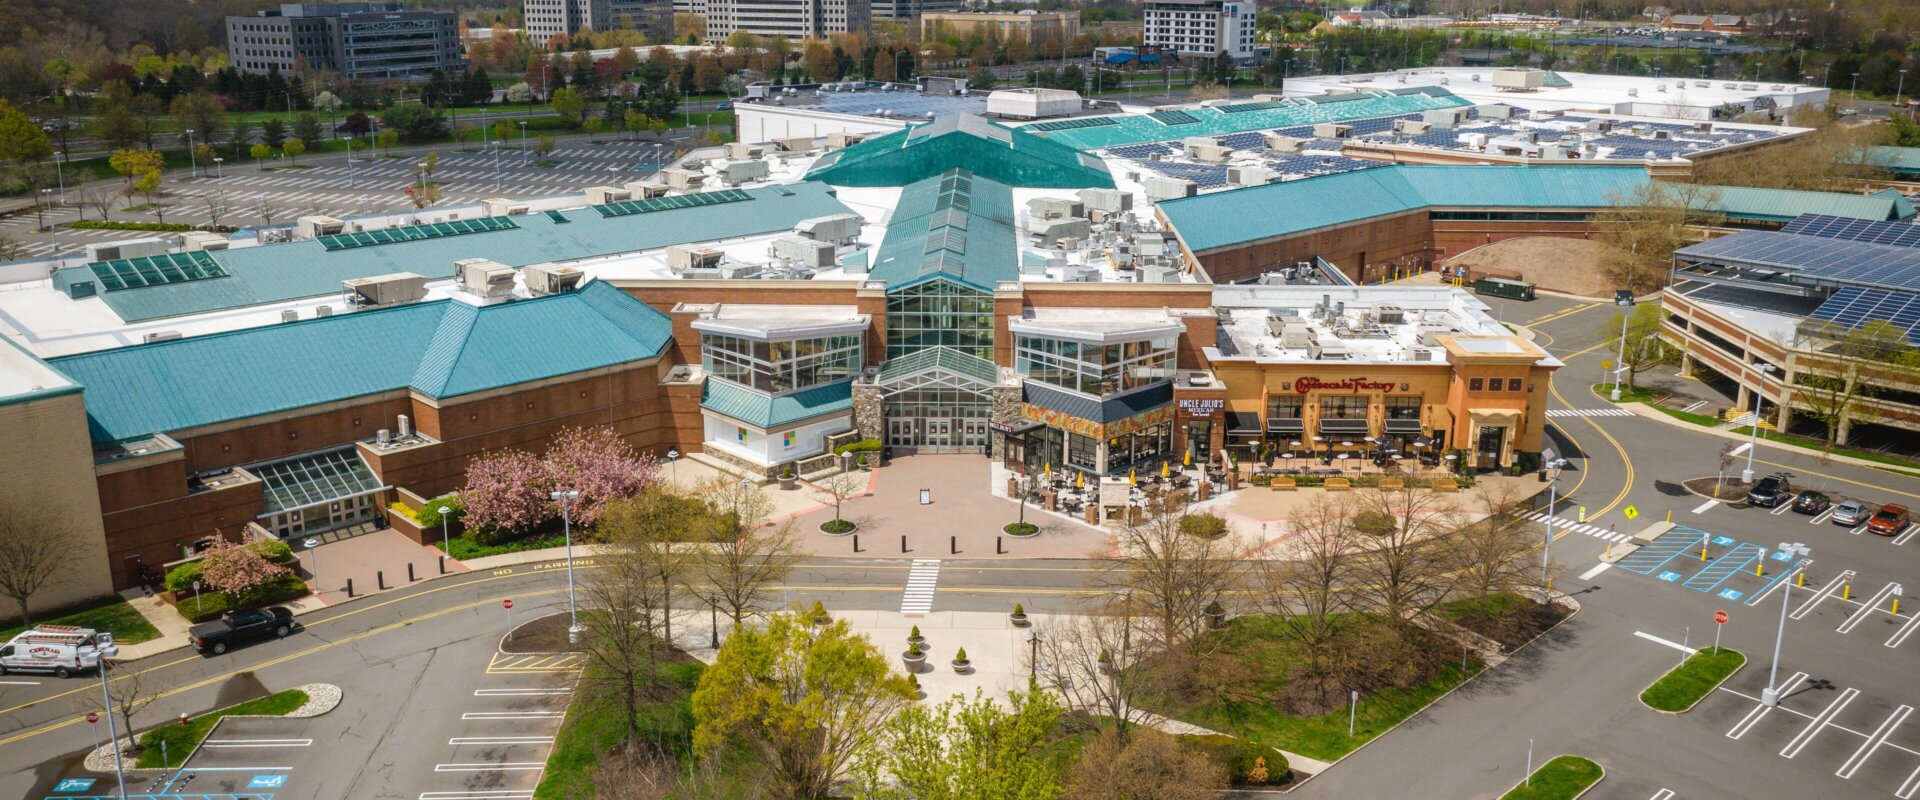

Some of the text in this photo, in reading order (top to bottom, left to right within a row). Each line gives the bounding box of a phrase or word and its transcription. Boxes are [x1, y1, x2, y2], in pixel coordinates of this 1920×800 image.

[1295, 377, 1396, 394] Cheesecake Factory
[1179, 399, 1224, 408] UNCLE JULIO'S
[493, 560, 593, 576] NO PARKING
